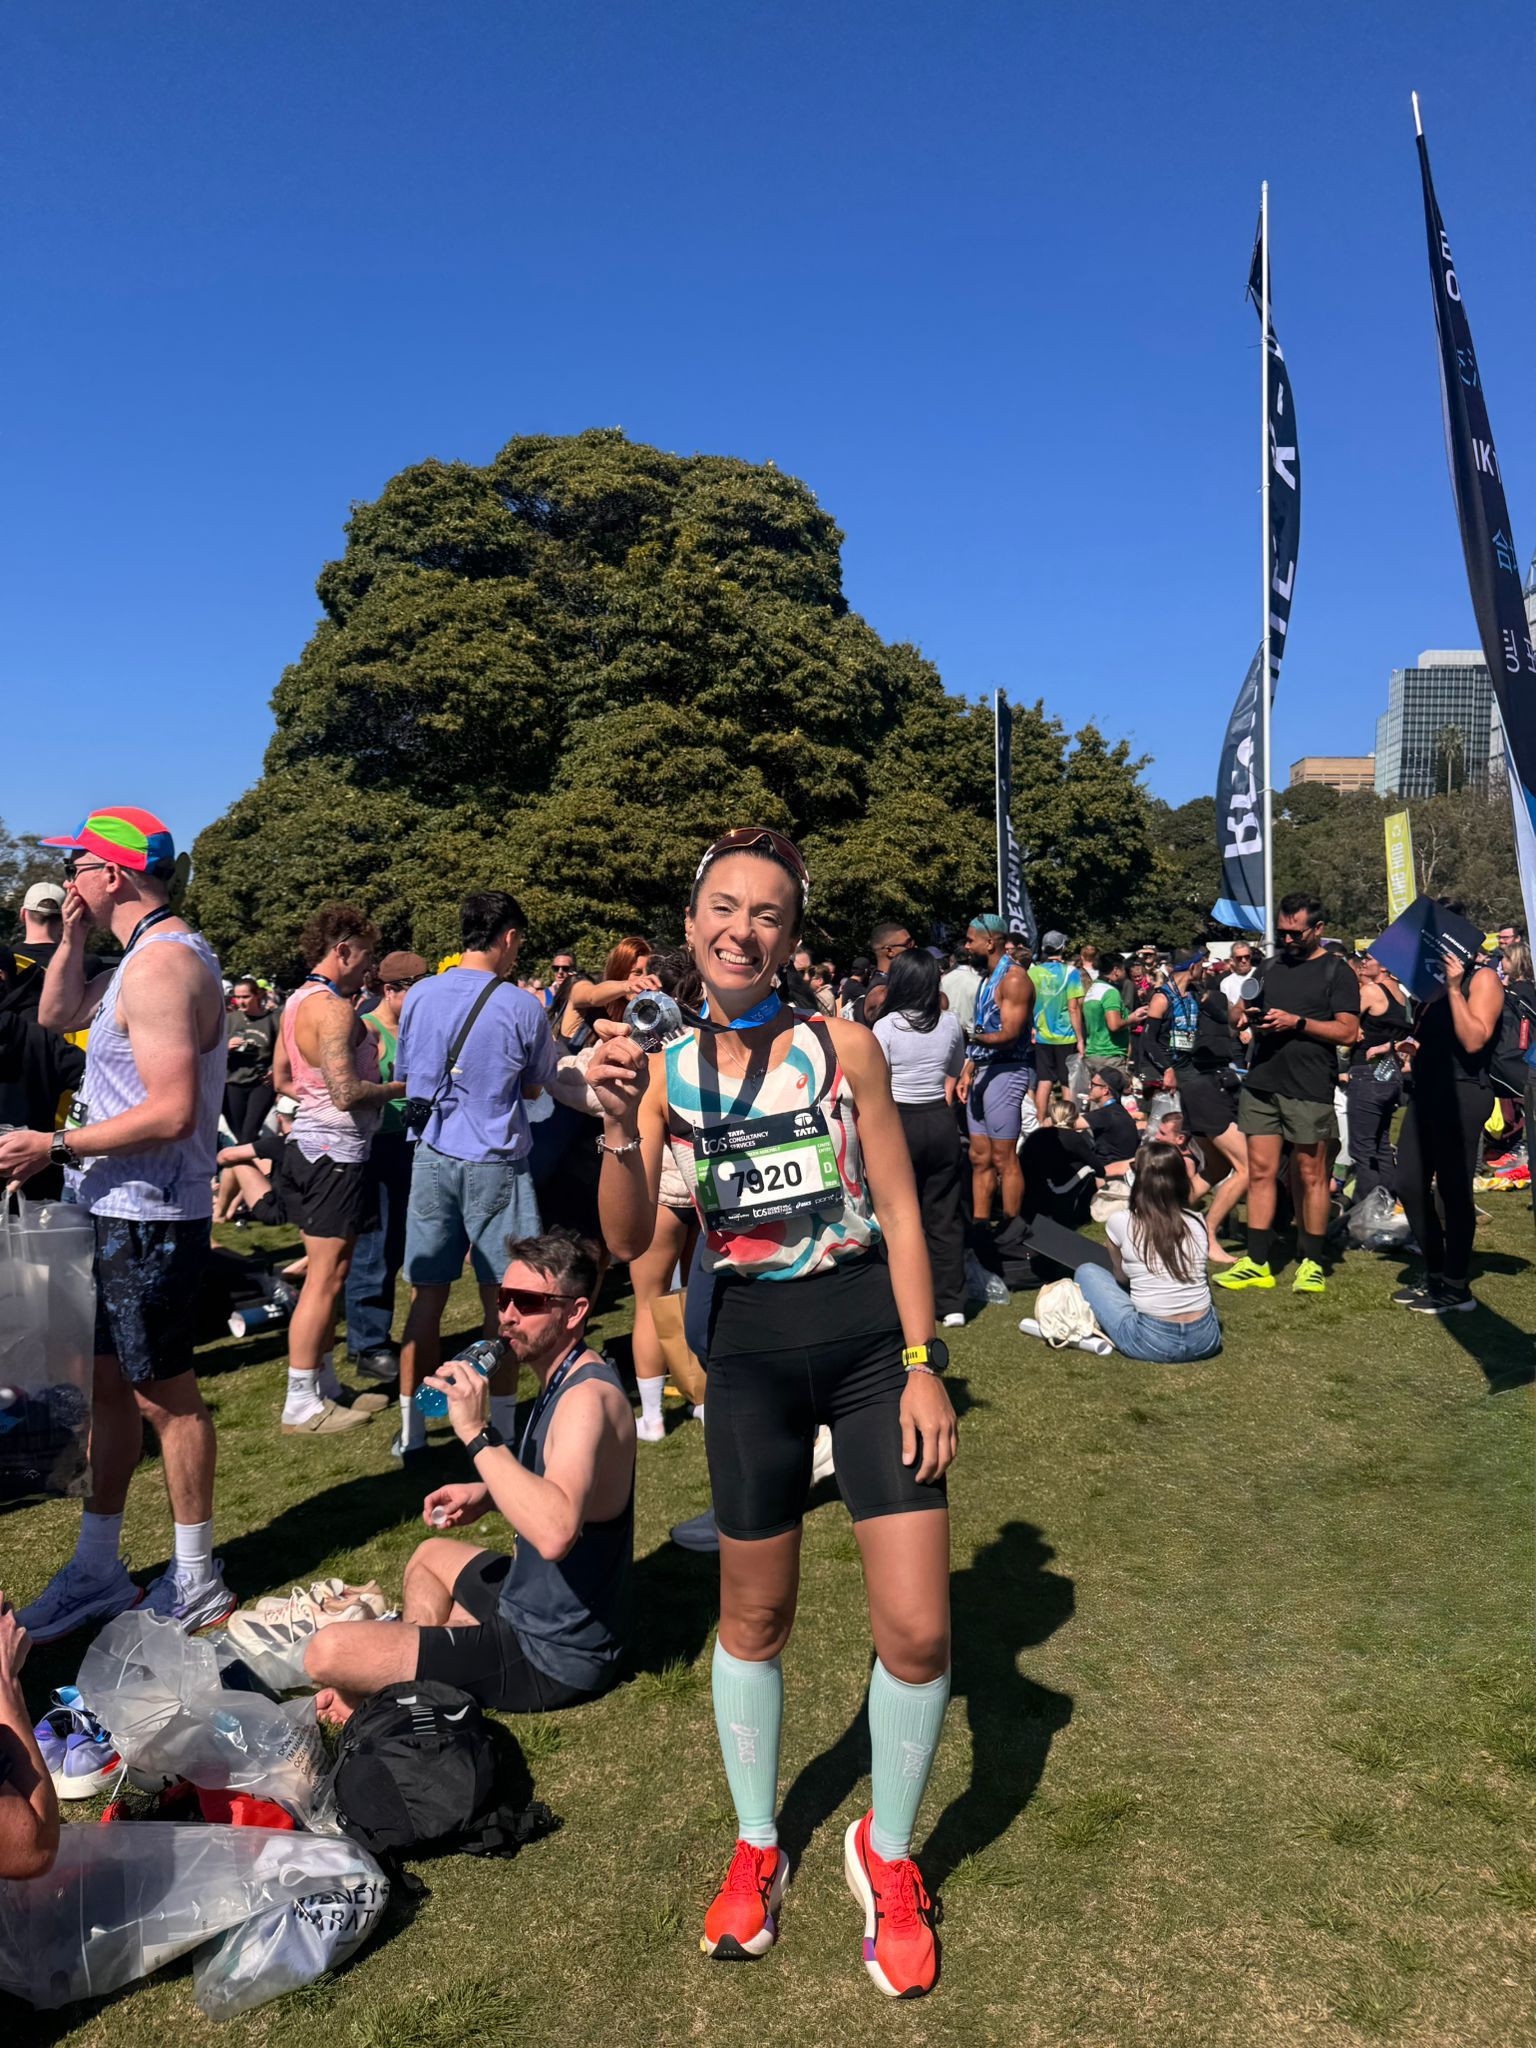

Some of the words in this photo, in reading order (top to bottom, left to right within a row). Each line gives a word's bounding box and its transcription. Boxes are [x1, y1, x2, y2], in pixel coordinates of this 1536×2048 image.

[727, 1129, 746, 1138] TATA
[728, 1131, 769, 1144] CONSULTANCY
[793, 1126, 819, 1137] TATA
[730, 1140, 756, 1151] SERVICES
[823, 1161, 833, 1174] D
[729, 1161, 803, 1198] 7920
